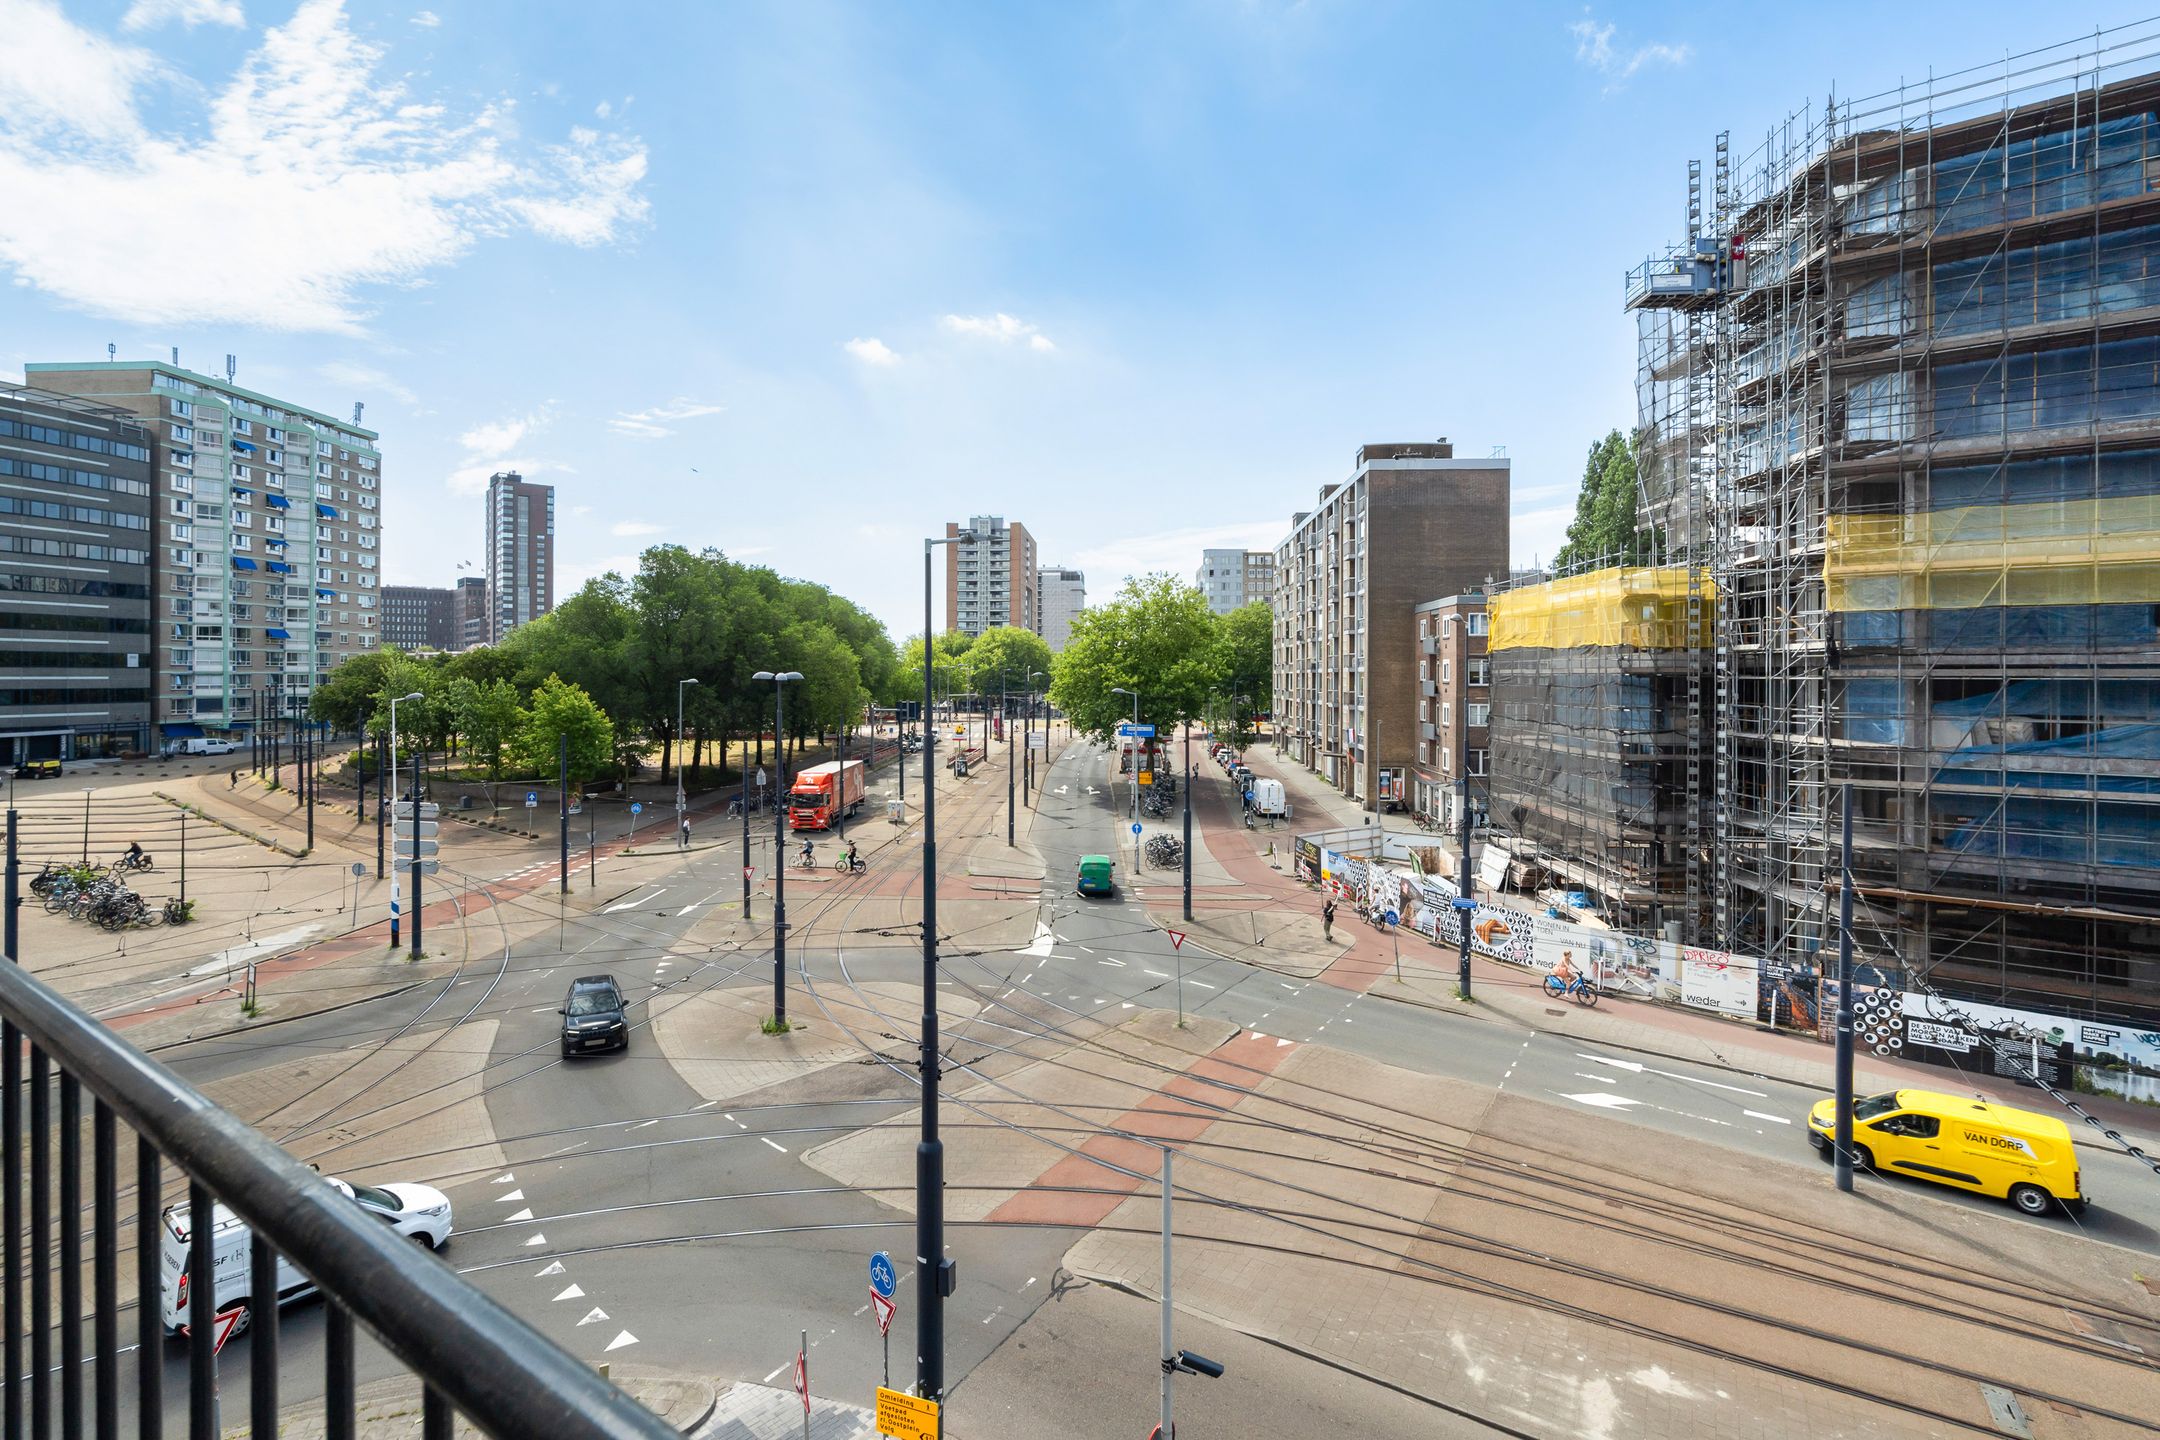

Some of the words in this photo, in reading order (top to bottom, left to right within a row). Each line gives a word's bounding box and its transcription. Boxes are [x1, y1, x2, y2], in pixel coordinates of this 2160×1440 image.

[1536, 919, 1561, 930] WONEN
[1560, 937, 1574, 946] VAN
[1535, 959, 1557, 969] wed
[1686, 994, 1721, 1007] weder
[1923, 1024, 1941, 1032] STAD
[1963, 1131, 1988, 1144] VAN
[1990, 1137, 2024, 1151] DORP
[880, 1392, 914, 1408] Omleiding
[880, 1403, 907, 1415] Voetpad
[880, 1410, 915, 1424] afgesloten
[880, 1423, 894, 1434] Volg
